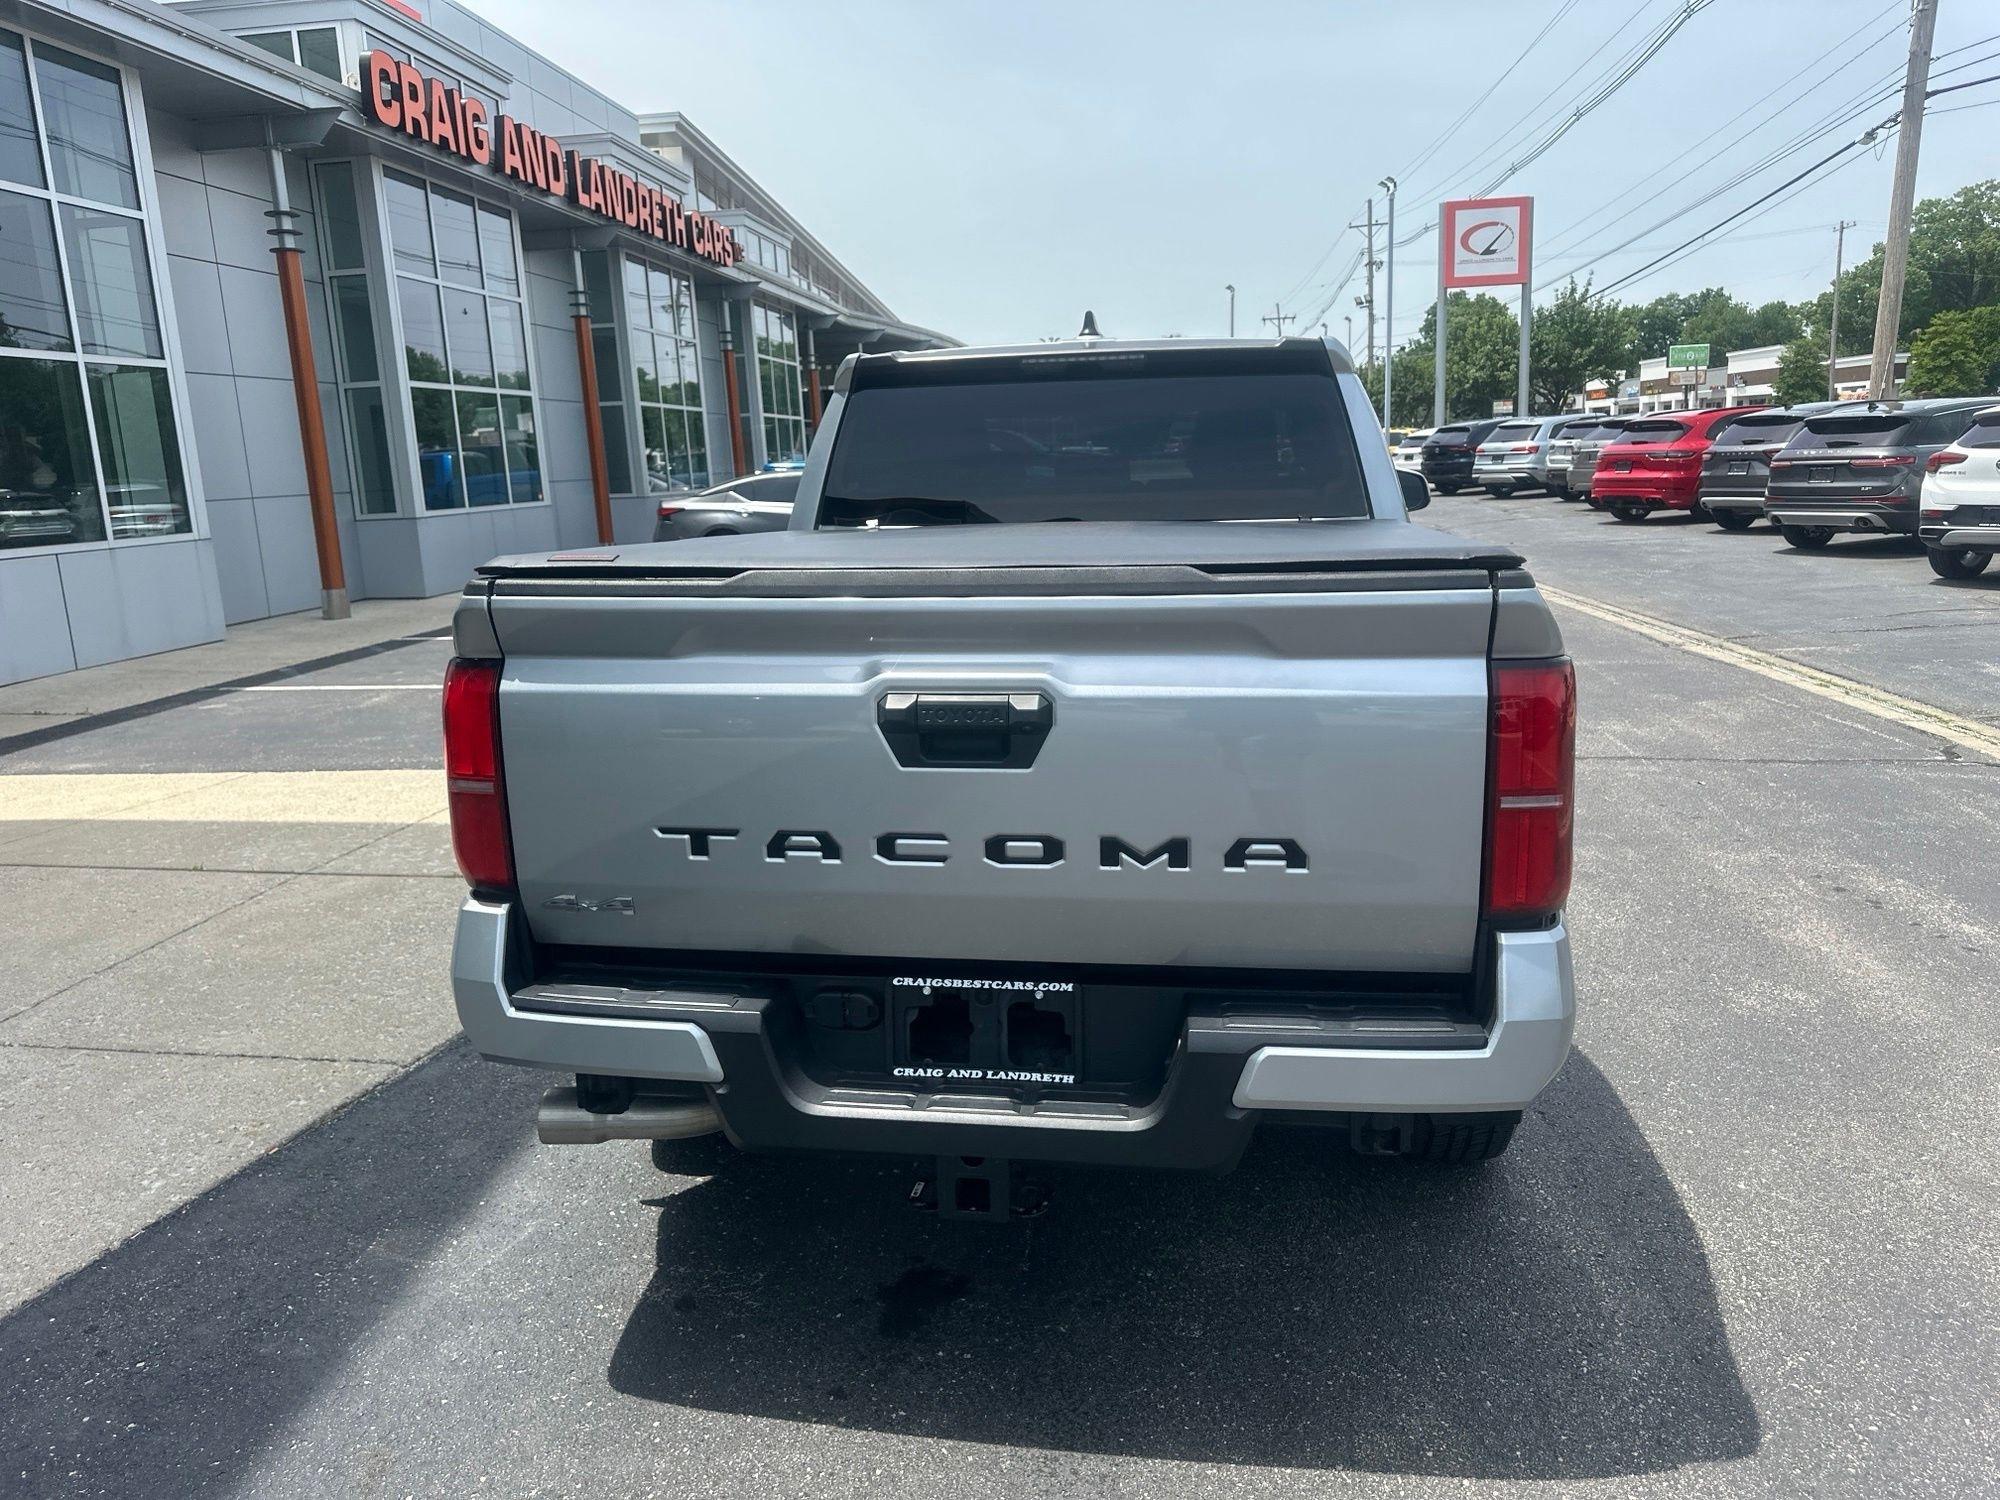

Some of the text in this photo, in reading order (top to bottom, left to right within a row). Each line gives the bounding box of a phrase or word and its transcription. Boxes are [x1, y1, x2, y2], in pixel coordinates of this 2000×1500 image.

[363, 48, 734, 267] CRAIG AND LANDRETH CARS
[921, 710, 1004, 723] TOYOTA
[651, 826, 1310, 874] TACOMA
[892, 977, 1073, 991] CRAIGSBESTCARS.COM
[893, 1067, 1076, 1084] CRAIG AND LANDRETH
